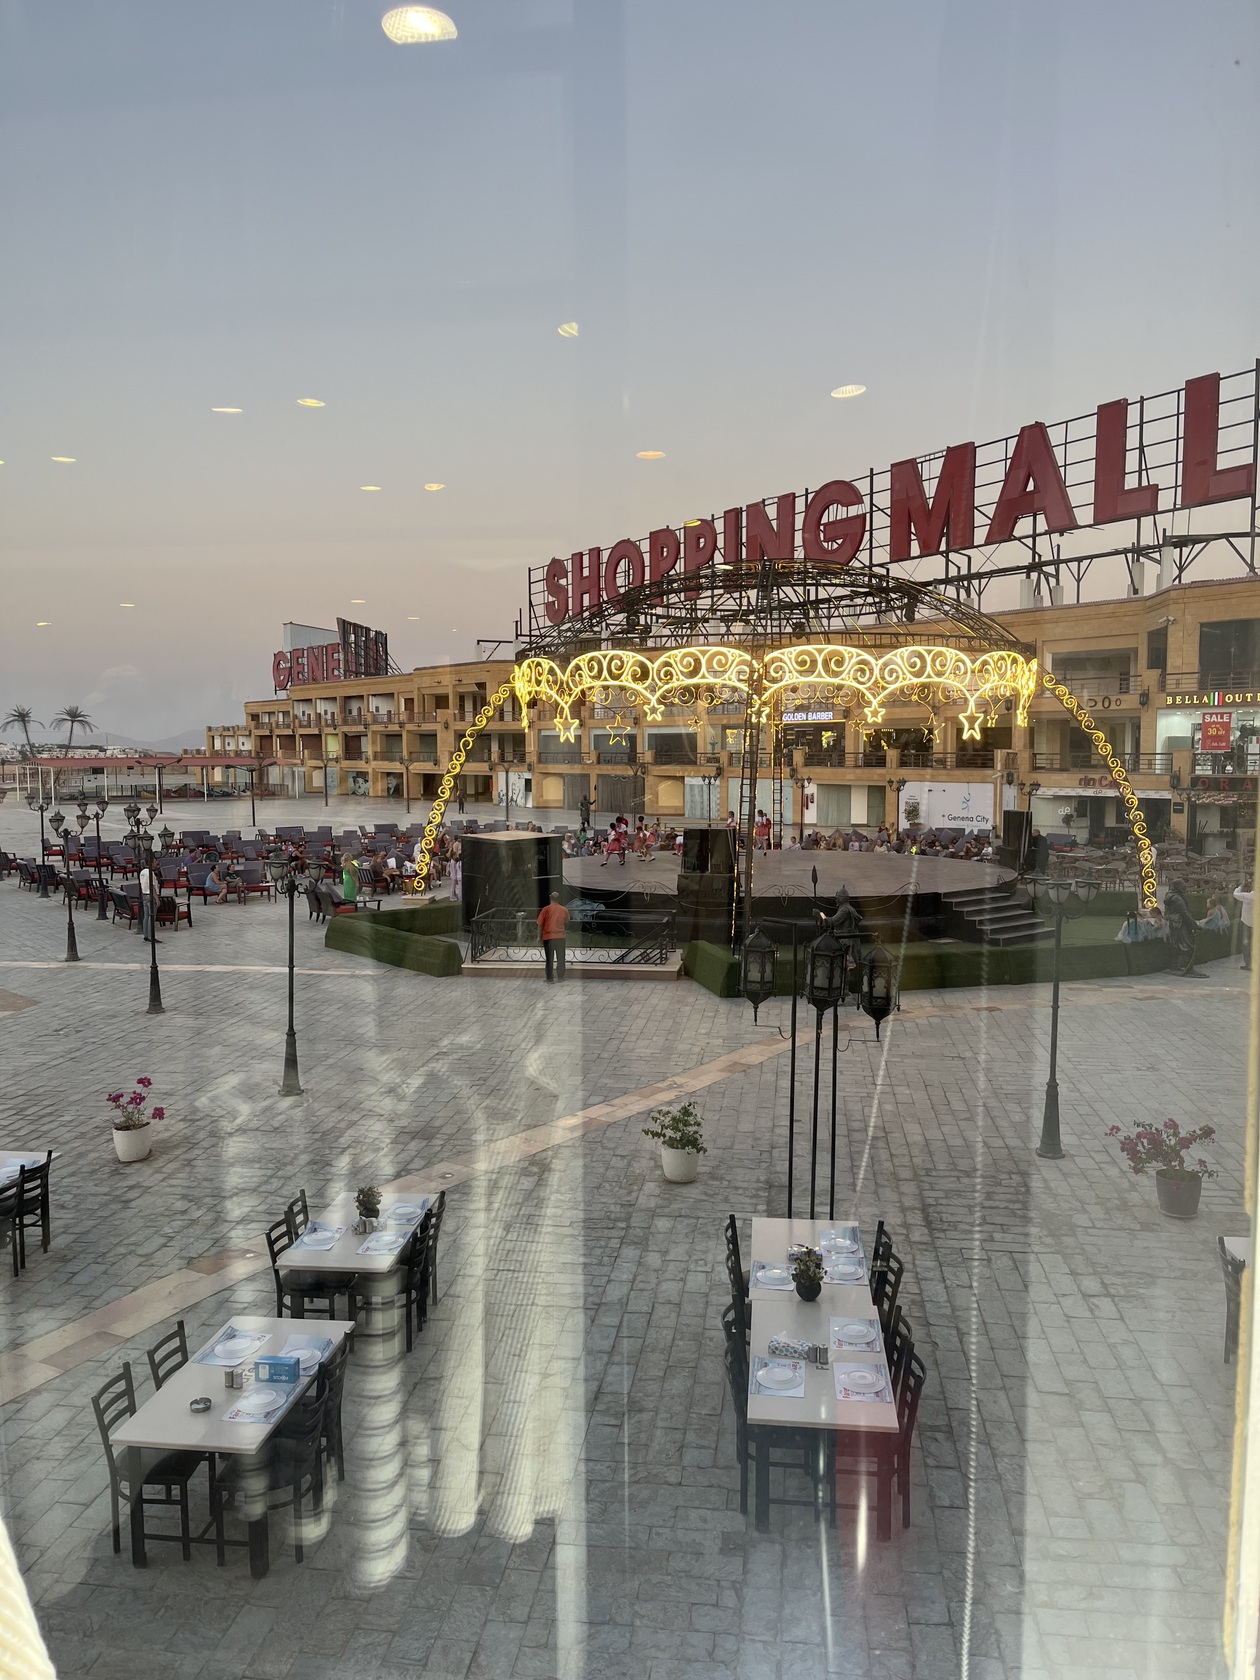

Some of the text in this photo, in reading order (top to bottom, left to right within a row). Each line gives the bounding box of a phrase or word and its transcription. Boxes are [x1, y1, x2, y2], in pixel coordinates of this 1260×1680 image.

[545, 372, 1254, 624] SHOPPING MALL
[1166, 694, 1209, 704] BELLA
[783, 711, 833, 721] GOLDEN BARBER
[1204, 713, 1230, 722] SALE
[947, 813, 990, 825] Genena City
